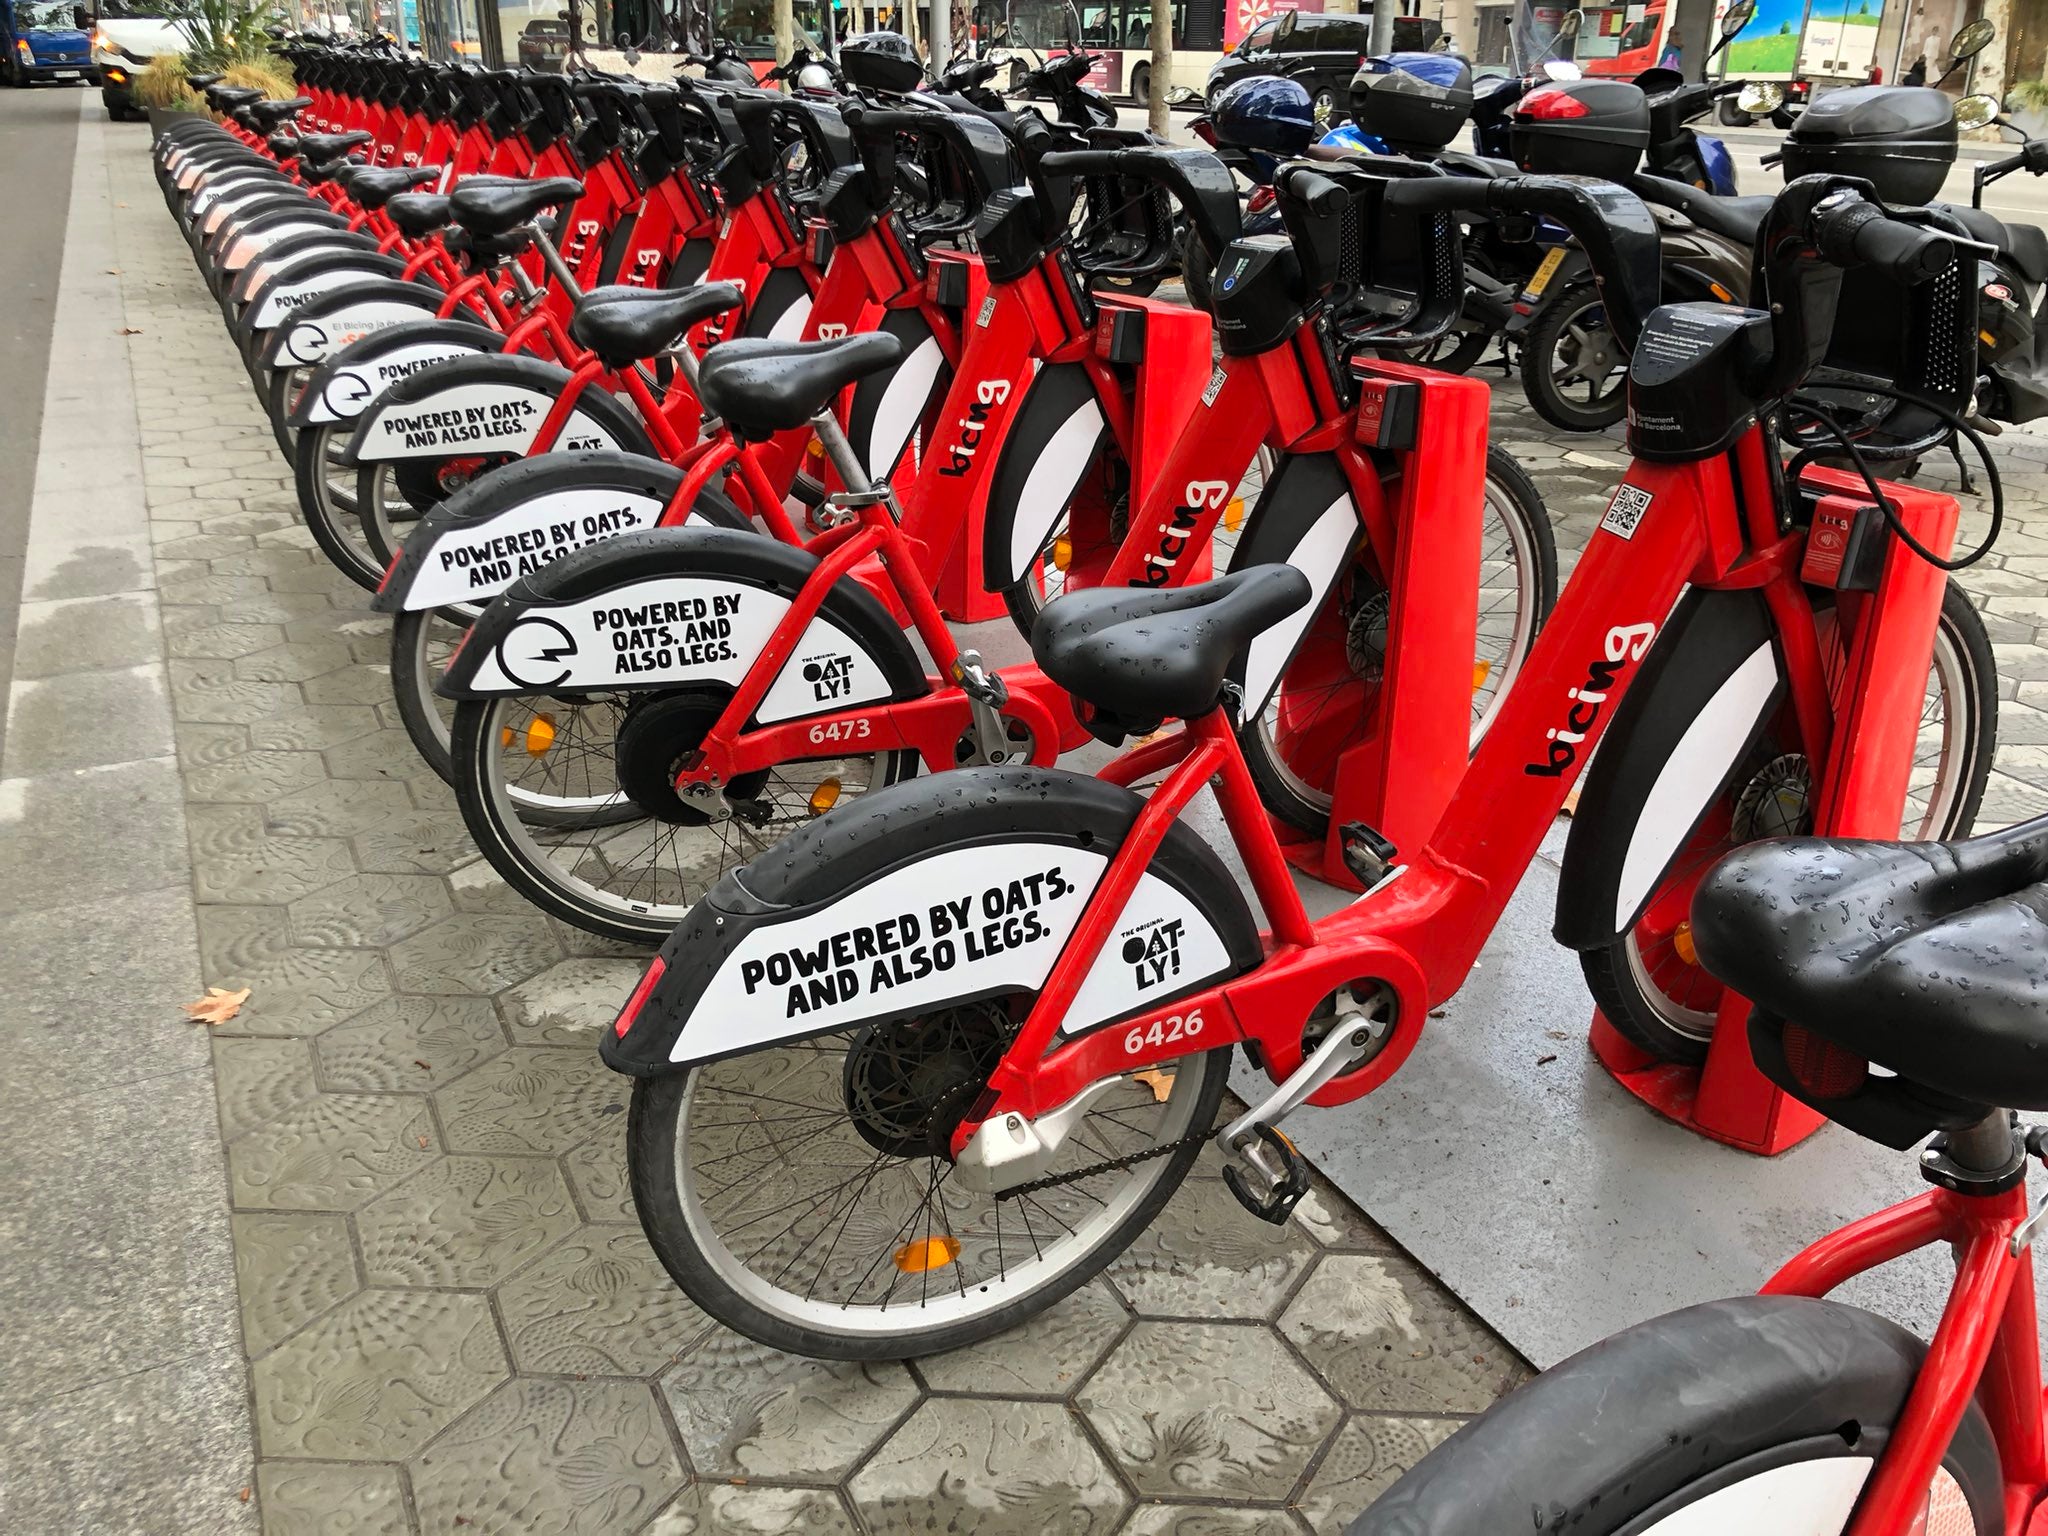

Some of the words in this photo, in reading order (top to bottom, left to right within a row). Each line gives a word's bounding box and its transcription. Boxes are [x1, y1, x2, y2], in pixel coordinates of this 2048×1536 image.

[384, 410, 463, 436] POWERED
[466, 407, 485, 424] BY
[490, 400, 537, 419] OATS.
[406, 430, 438, 449] AND
[442, 425, 480, 444] ALSO
[484, 418, 527, 438] LEGS.
[939, 379, 1011, 478] bicing
[440, 529, 546, 572] POWERED
[550, 520, 576, 545] BY
[582, 506, 642, 536] OATS.
[1128, 480, 1229, 588] bicing
[469, 560, 511, 588] AND
[593, 598, 707, 631] POWERED
[713, 593, 741, 616] BY
[612, 626, 679, 651] OATS.
[685, 618, 731, 643] AND
[615, 649, 672, 674] ALSO
[678, 641, 737, 666] LEGS.
[1524, 622, 1656, 777] bicing
[809, 718, 871, 744] 6473
[741, 913, 921, 995] POWERED
[929, 895, 972, 938] BY
[982, 866, 1075, 919] OATS.
[1121, 928, 1135, 938] THE
[1136, 917, 1164, 932] ORIGINAL
[787, 969, 859, 1018] AND
[870, 939, 956, 993] ALSO
[964, 910, 1051, 962] LEGS.
[1124, 1008, 1204, 1054] 6426
